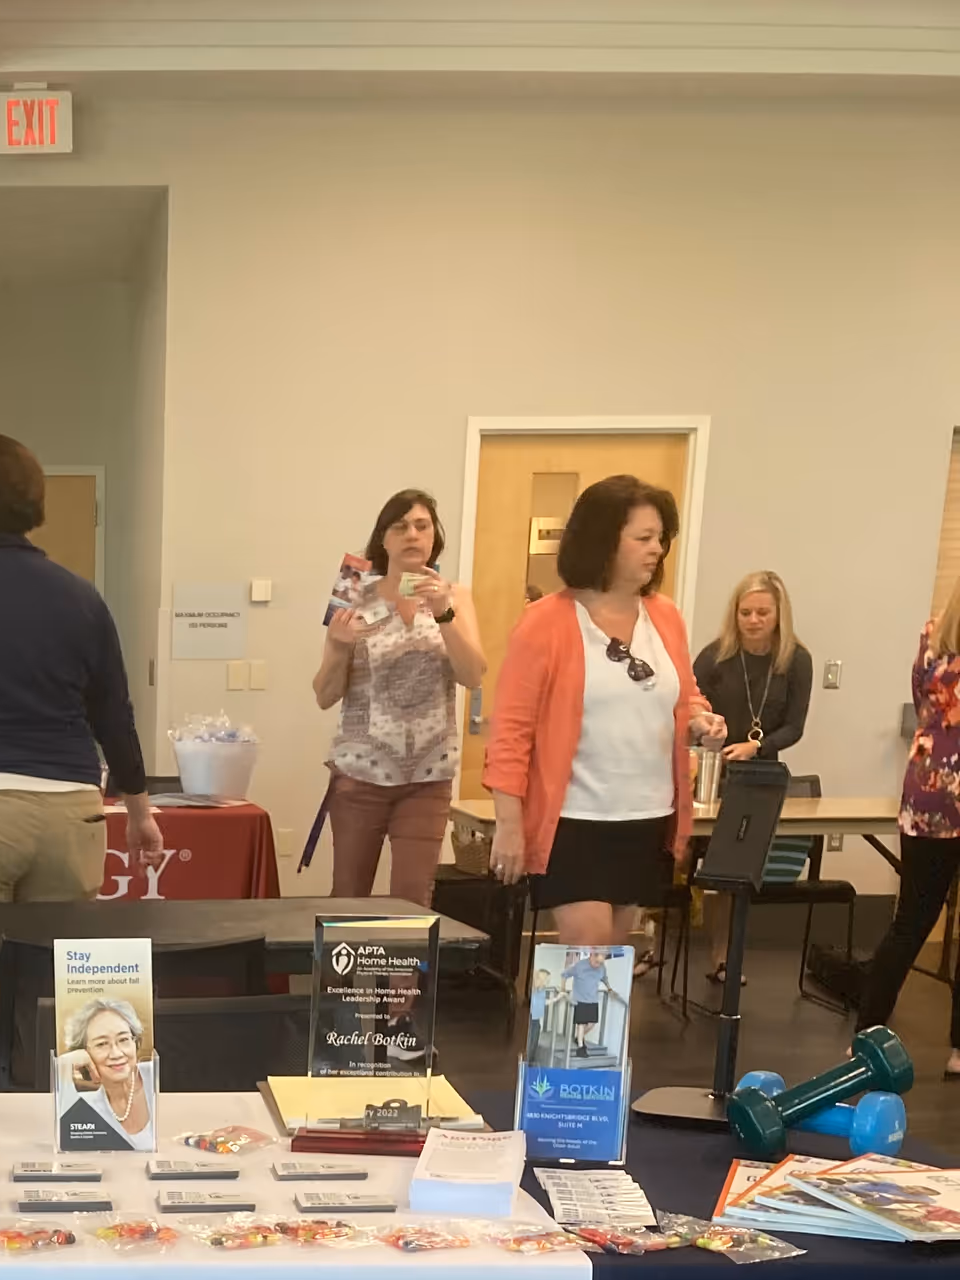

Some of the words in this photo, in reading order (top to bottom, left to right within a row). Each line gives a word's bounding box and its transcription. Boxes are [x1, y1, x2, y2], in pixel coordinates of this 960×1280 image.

[6, 98, 59, 146] EXIT
[66, 950, 91, 962] Stay
[356, 946, 386, 956] APTA
[357, 957, 388, 966] Home
[388, 957, 421, 966] Health
[66, 963, 140, 976] Independent
[398, 988, 421, 996] Health
[342, 994, 380, 1004] Leadership
[382, 996, 406, 1004] Award
[326, 1030, 372, 1046] Rachel
[372, 1032, 416, 1048] Botkin
[358, 1061, 392, 1069] recognition
[340, 1068, 374, 1077] exceptional
[560, 1084, 616, 1100] BOTKIN
